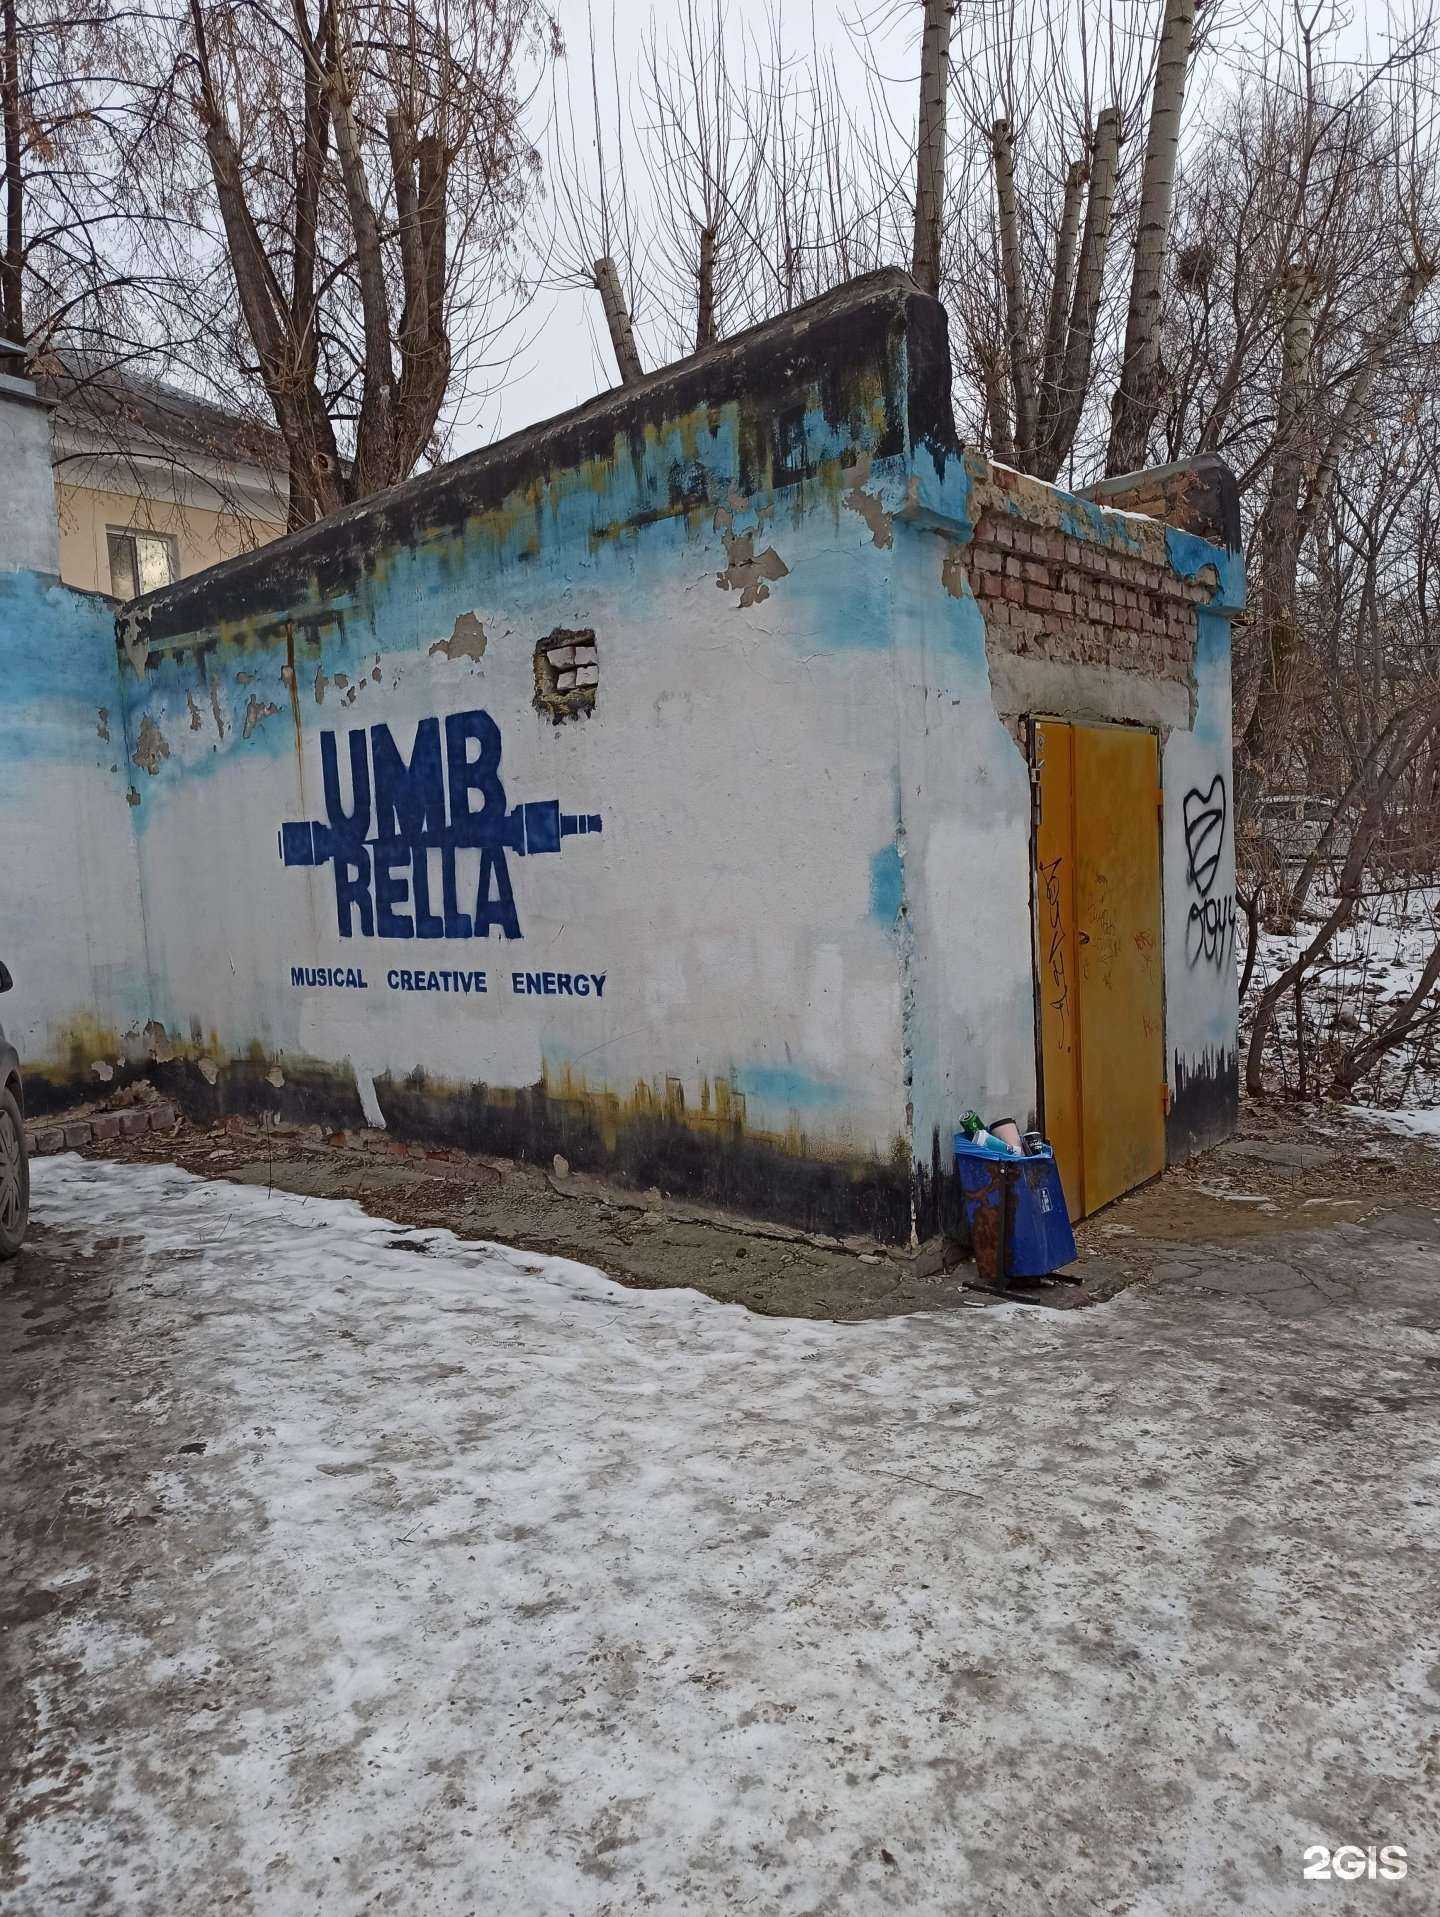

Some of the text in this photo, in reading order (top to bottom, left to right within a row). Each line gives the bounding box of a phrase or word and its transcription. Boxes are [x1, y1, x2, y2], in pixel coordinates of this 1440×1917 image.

[320, 710, 507, 842] UMB
[333, 843, 524, 939] RELLA
[291, 967, 607, 997] MUSICAL CREATIVE ENERGY
